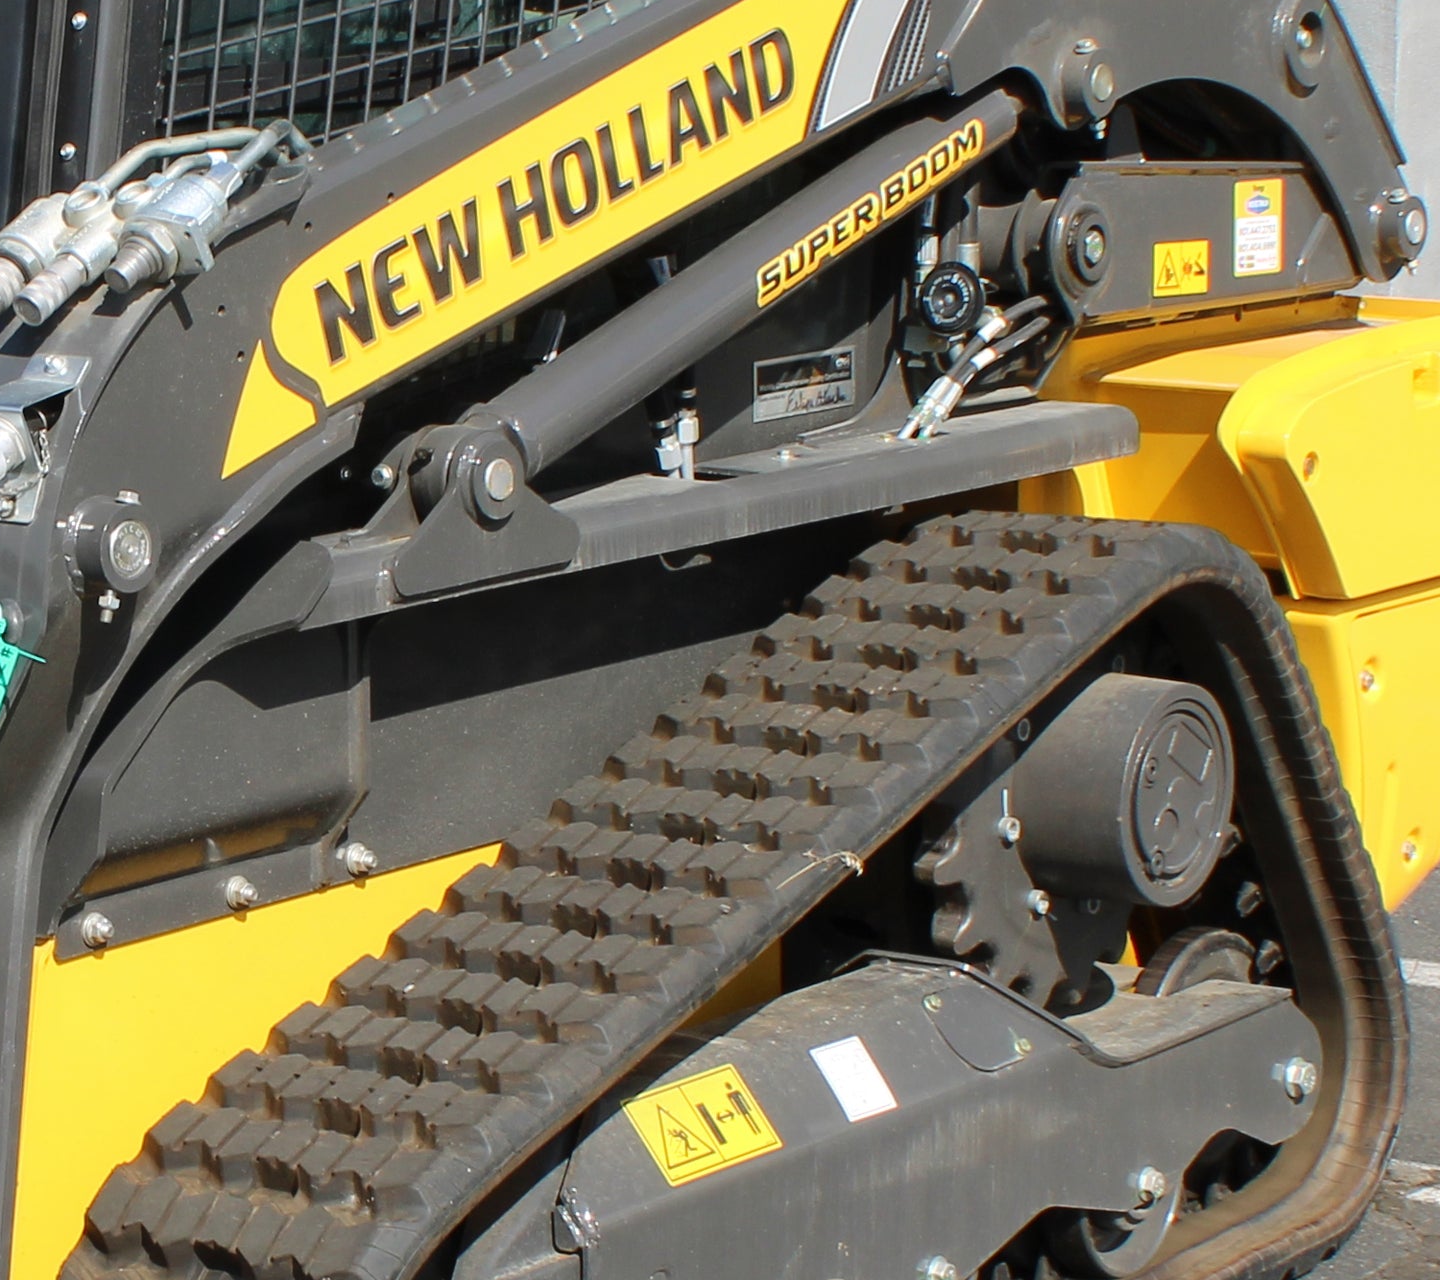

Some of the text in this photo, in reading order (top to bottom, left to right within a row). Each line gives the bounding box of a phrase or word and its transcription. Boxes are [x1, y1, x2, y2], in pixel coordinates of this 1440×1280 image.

[312, 26, 796, 368] NEW HOLLAND
[758, 194, 878, 305] SUPER
[882, 121, 983, 217] BOOM
[0, 646, 14, 658] #
